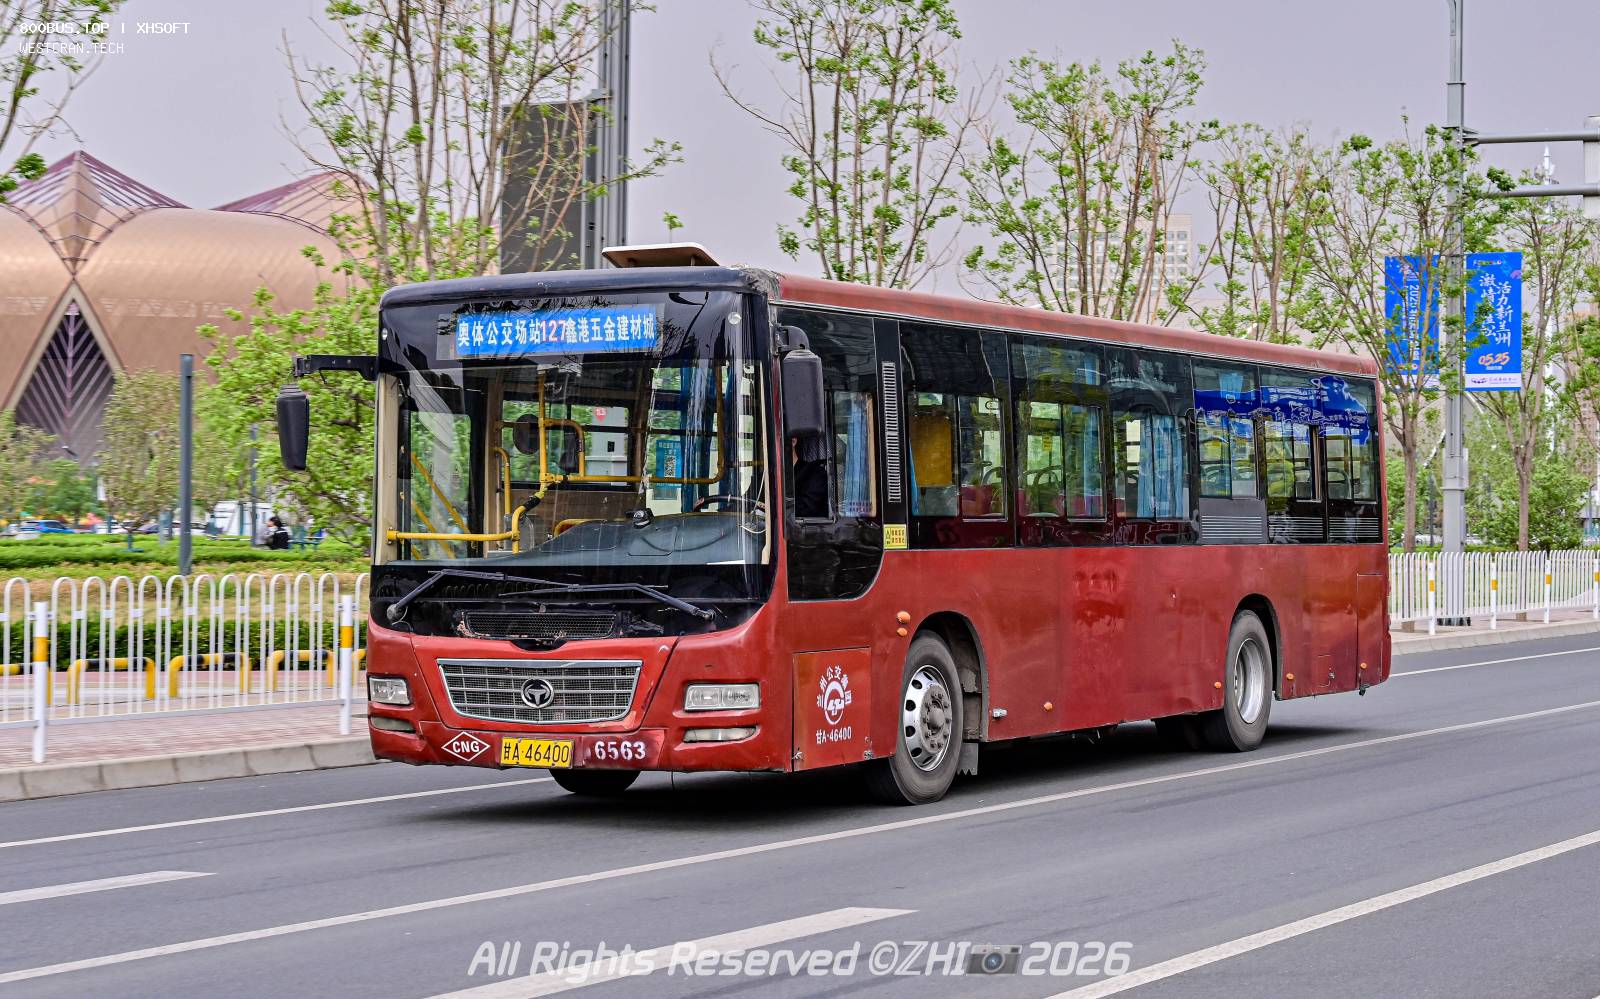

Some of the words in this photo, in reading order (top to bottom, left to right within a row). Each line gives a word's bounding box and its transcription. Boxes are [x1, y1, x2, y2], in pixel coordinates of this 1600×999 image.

[1494, 281, 1514, 348] 活力新兰州
[452, 740, 480, 753] CNG
[594, 740, 647, 760] 6563
